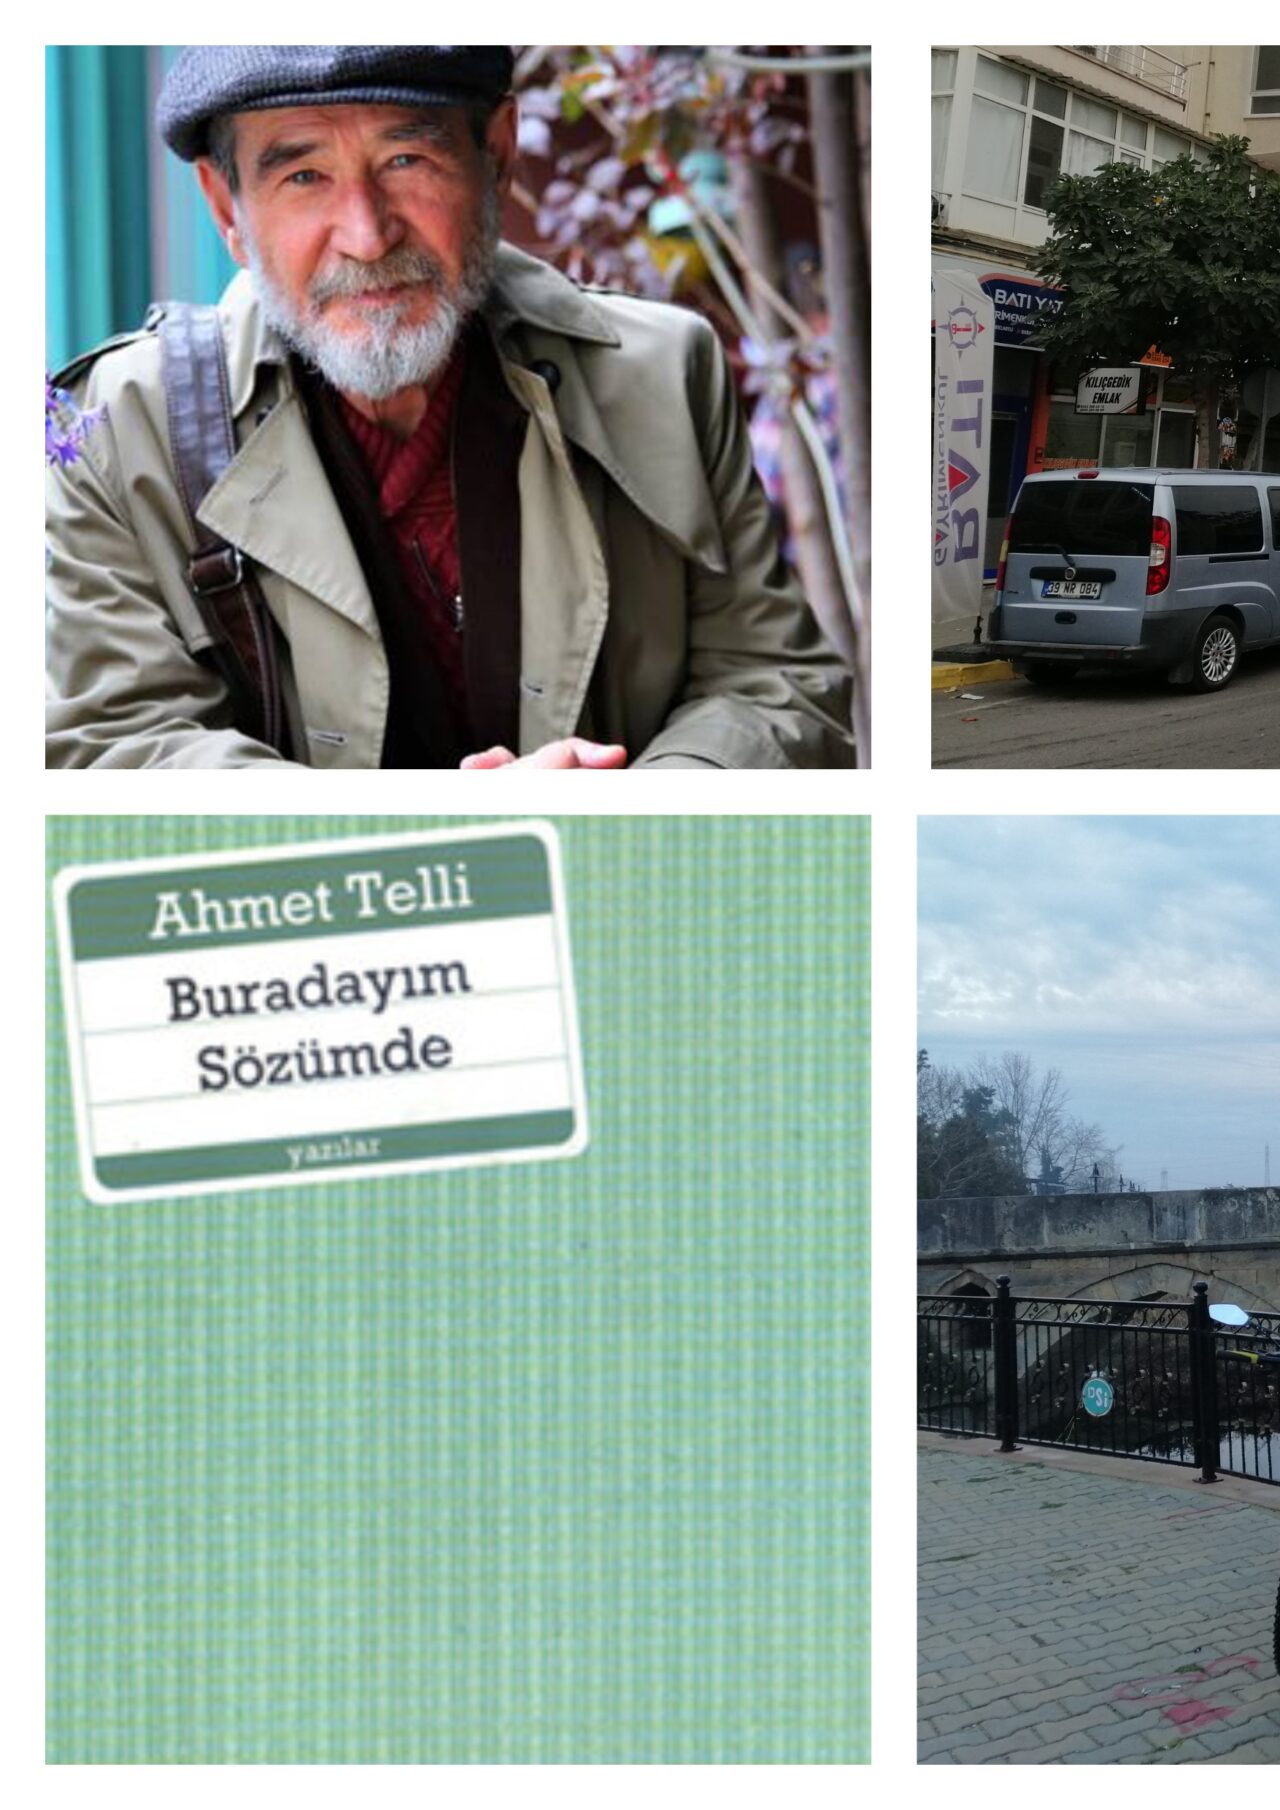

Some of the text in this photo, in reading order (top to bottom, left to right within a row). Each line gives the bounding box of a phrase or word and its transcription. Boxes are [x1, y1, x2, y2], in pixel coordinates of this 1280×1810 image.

[994, 288, 1065, 314] BATI YAT
[1084, 374, 1133, 392] KILIÇGEDİK
[1092, 392, 1122, 404] EMLAK
[1063, 582, 1076, 593] NR
[1079, 583, 1098, 594] 084
[149, 863, 473, 939] Ahmet Telli
[164, 960, 472, 1023] Buradayım
[197, 1026, 453, 1091] Sözümde
[286, 1135, 380, 1170] yazılar
